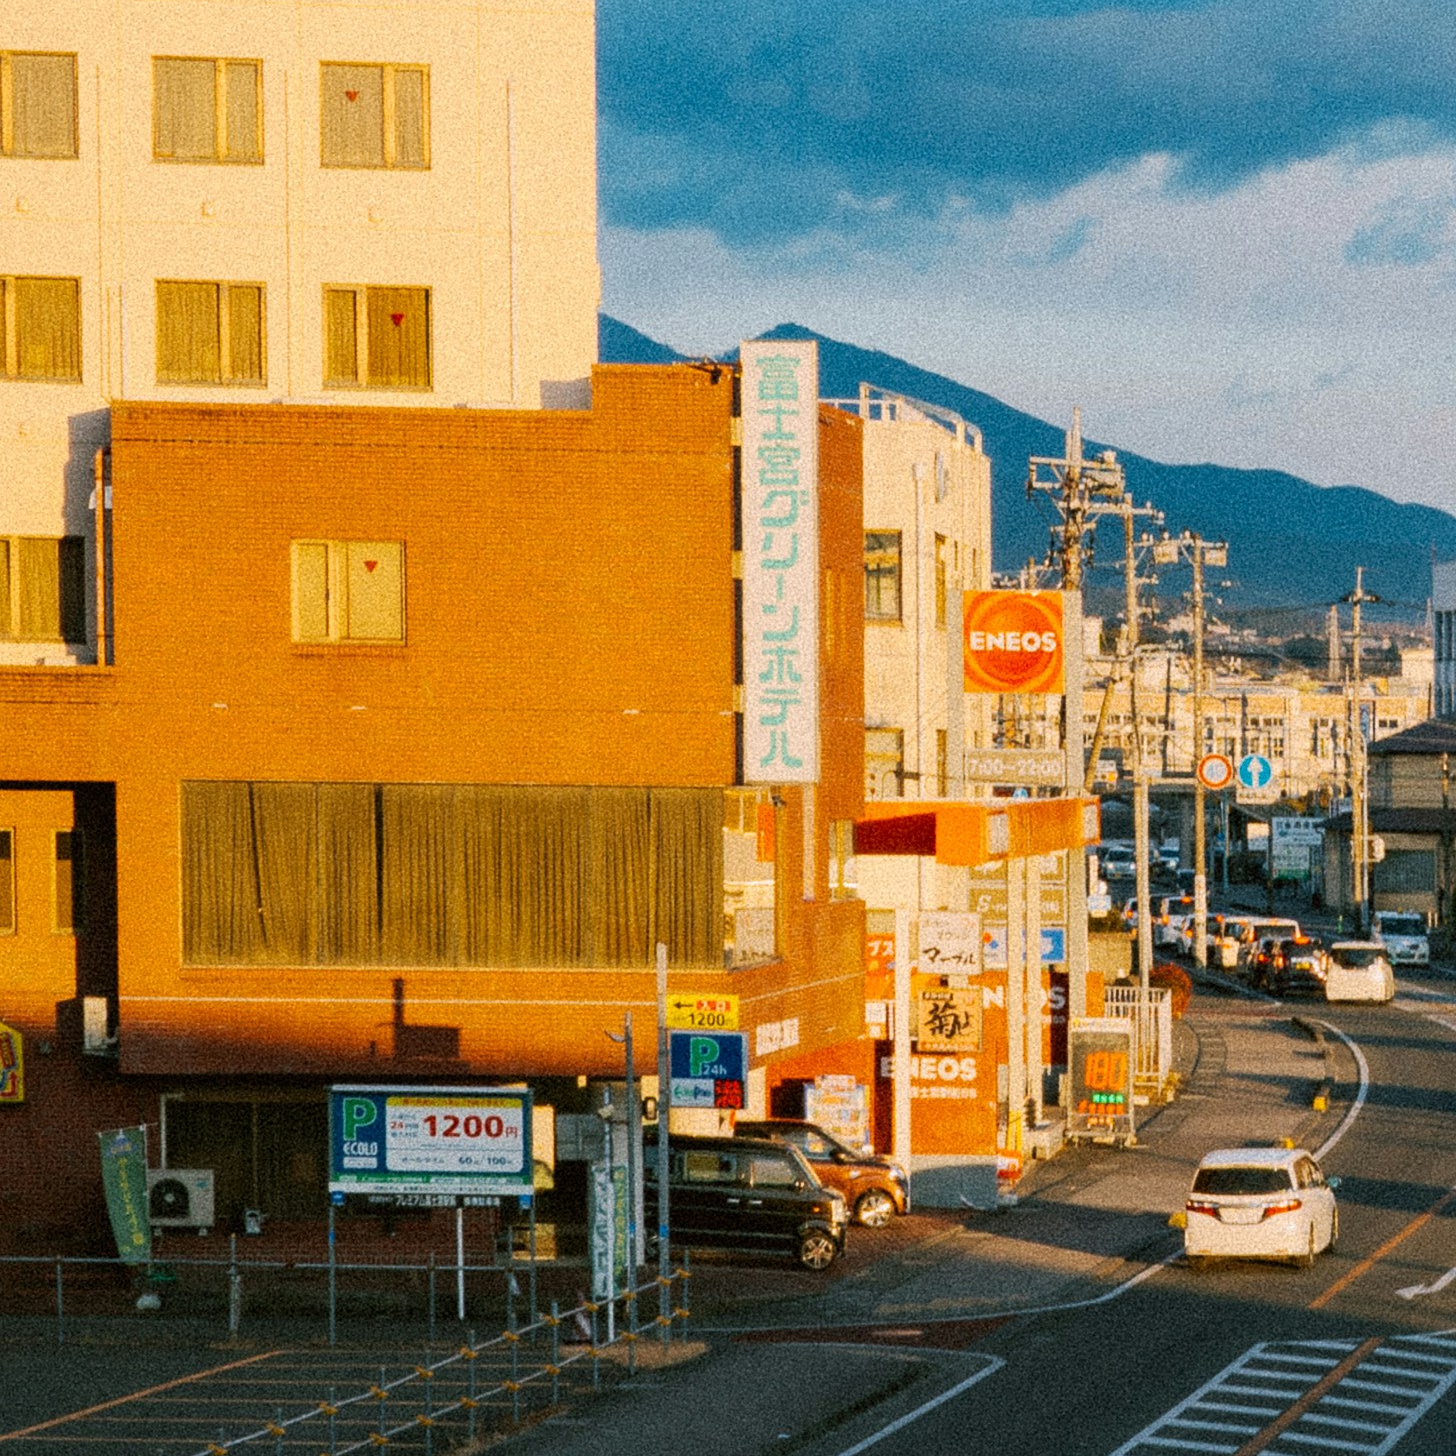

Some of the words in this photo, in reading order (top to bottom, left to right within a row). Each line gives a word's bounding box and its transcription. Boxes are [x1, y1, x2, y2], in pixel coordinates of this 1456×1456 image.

[755, 353, 808, 769] 富士宮グリーンホテル
[970, 630, 1057, 653] ENEOS
[688, 1013, 727, 1027] 1200
[689, 1036, 721, 1077] P
[702, 1063, 728, 1077] 24h
[342, 1096, 379, 1141] P
[423, 1113, 519, 1139] 1200円
